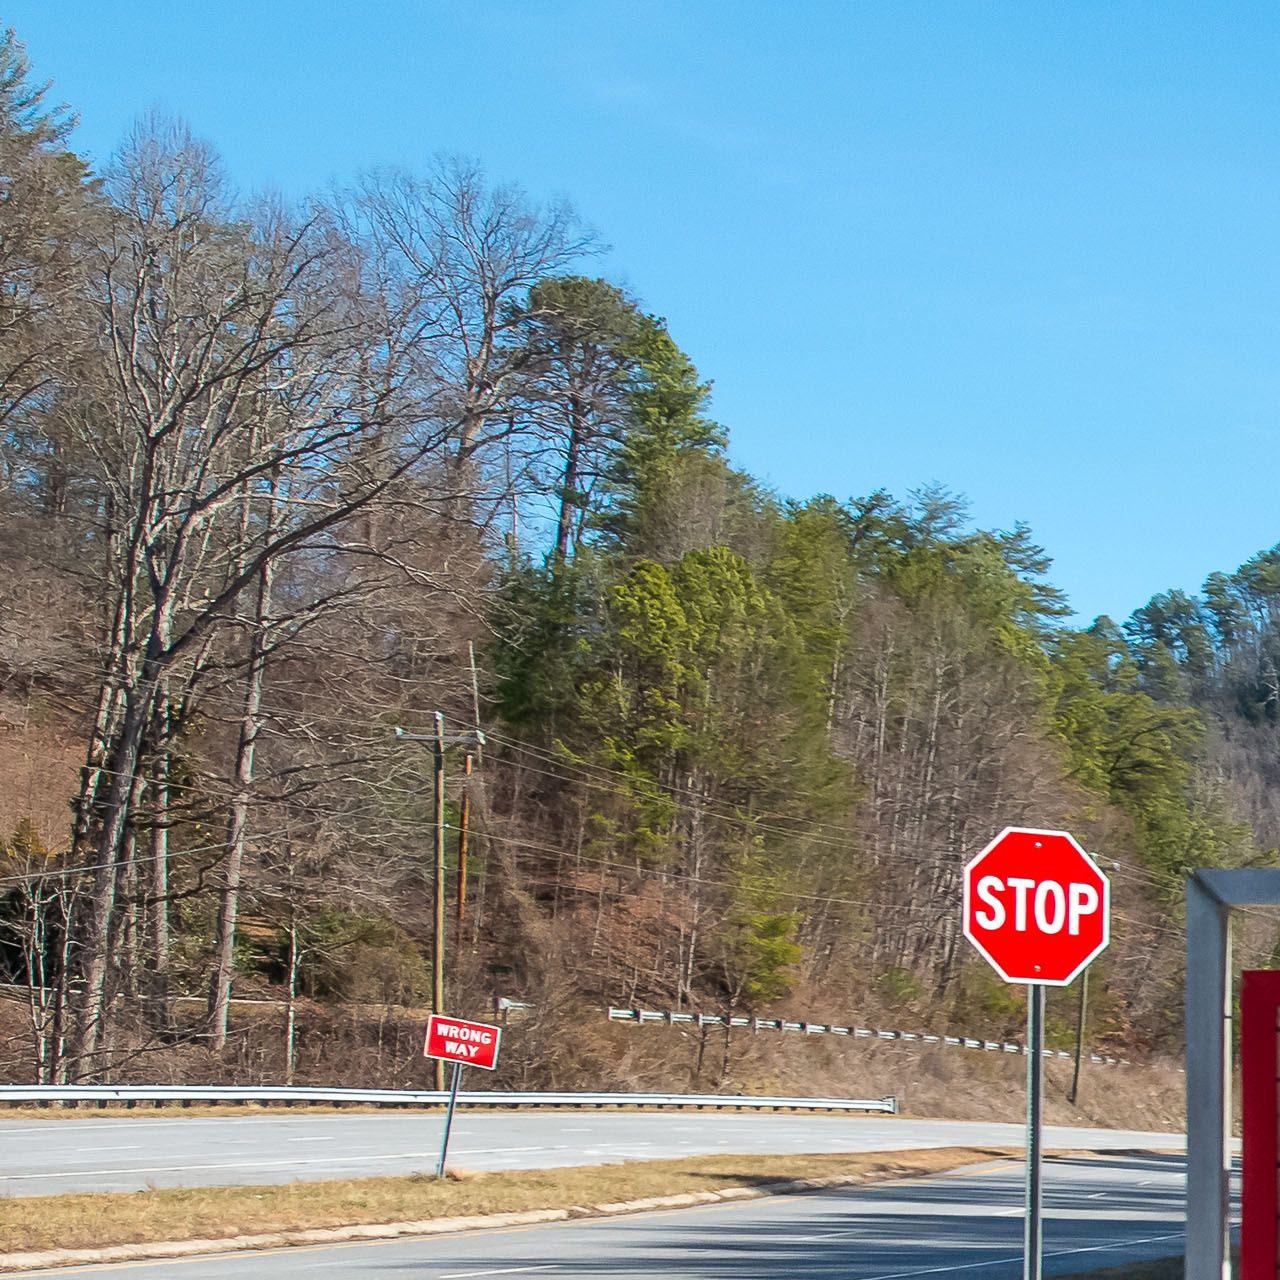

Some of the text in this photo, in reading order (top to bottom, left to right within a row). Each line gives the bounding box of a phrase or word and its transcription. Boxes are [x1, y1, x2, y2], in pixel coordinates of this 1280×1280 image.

[975, 875, 1099, 935] STOP
[436, 1023, 492, 1044] WRONG
[445, 1041, 479, 1057] WAY
